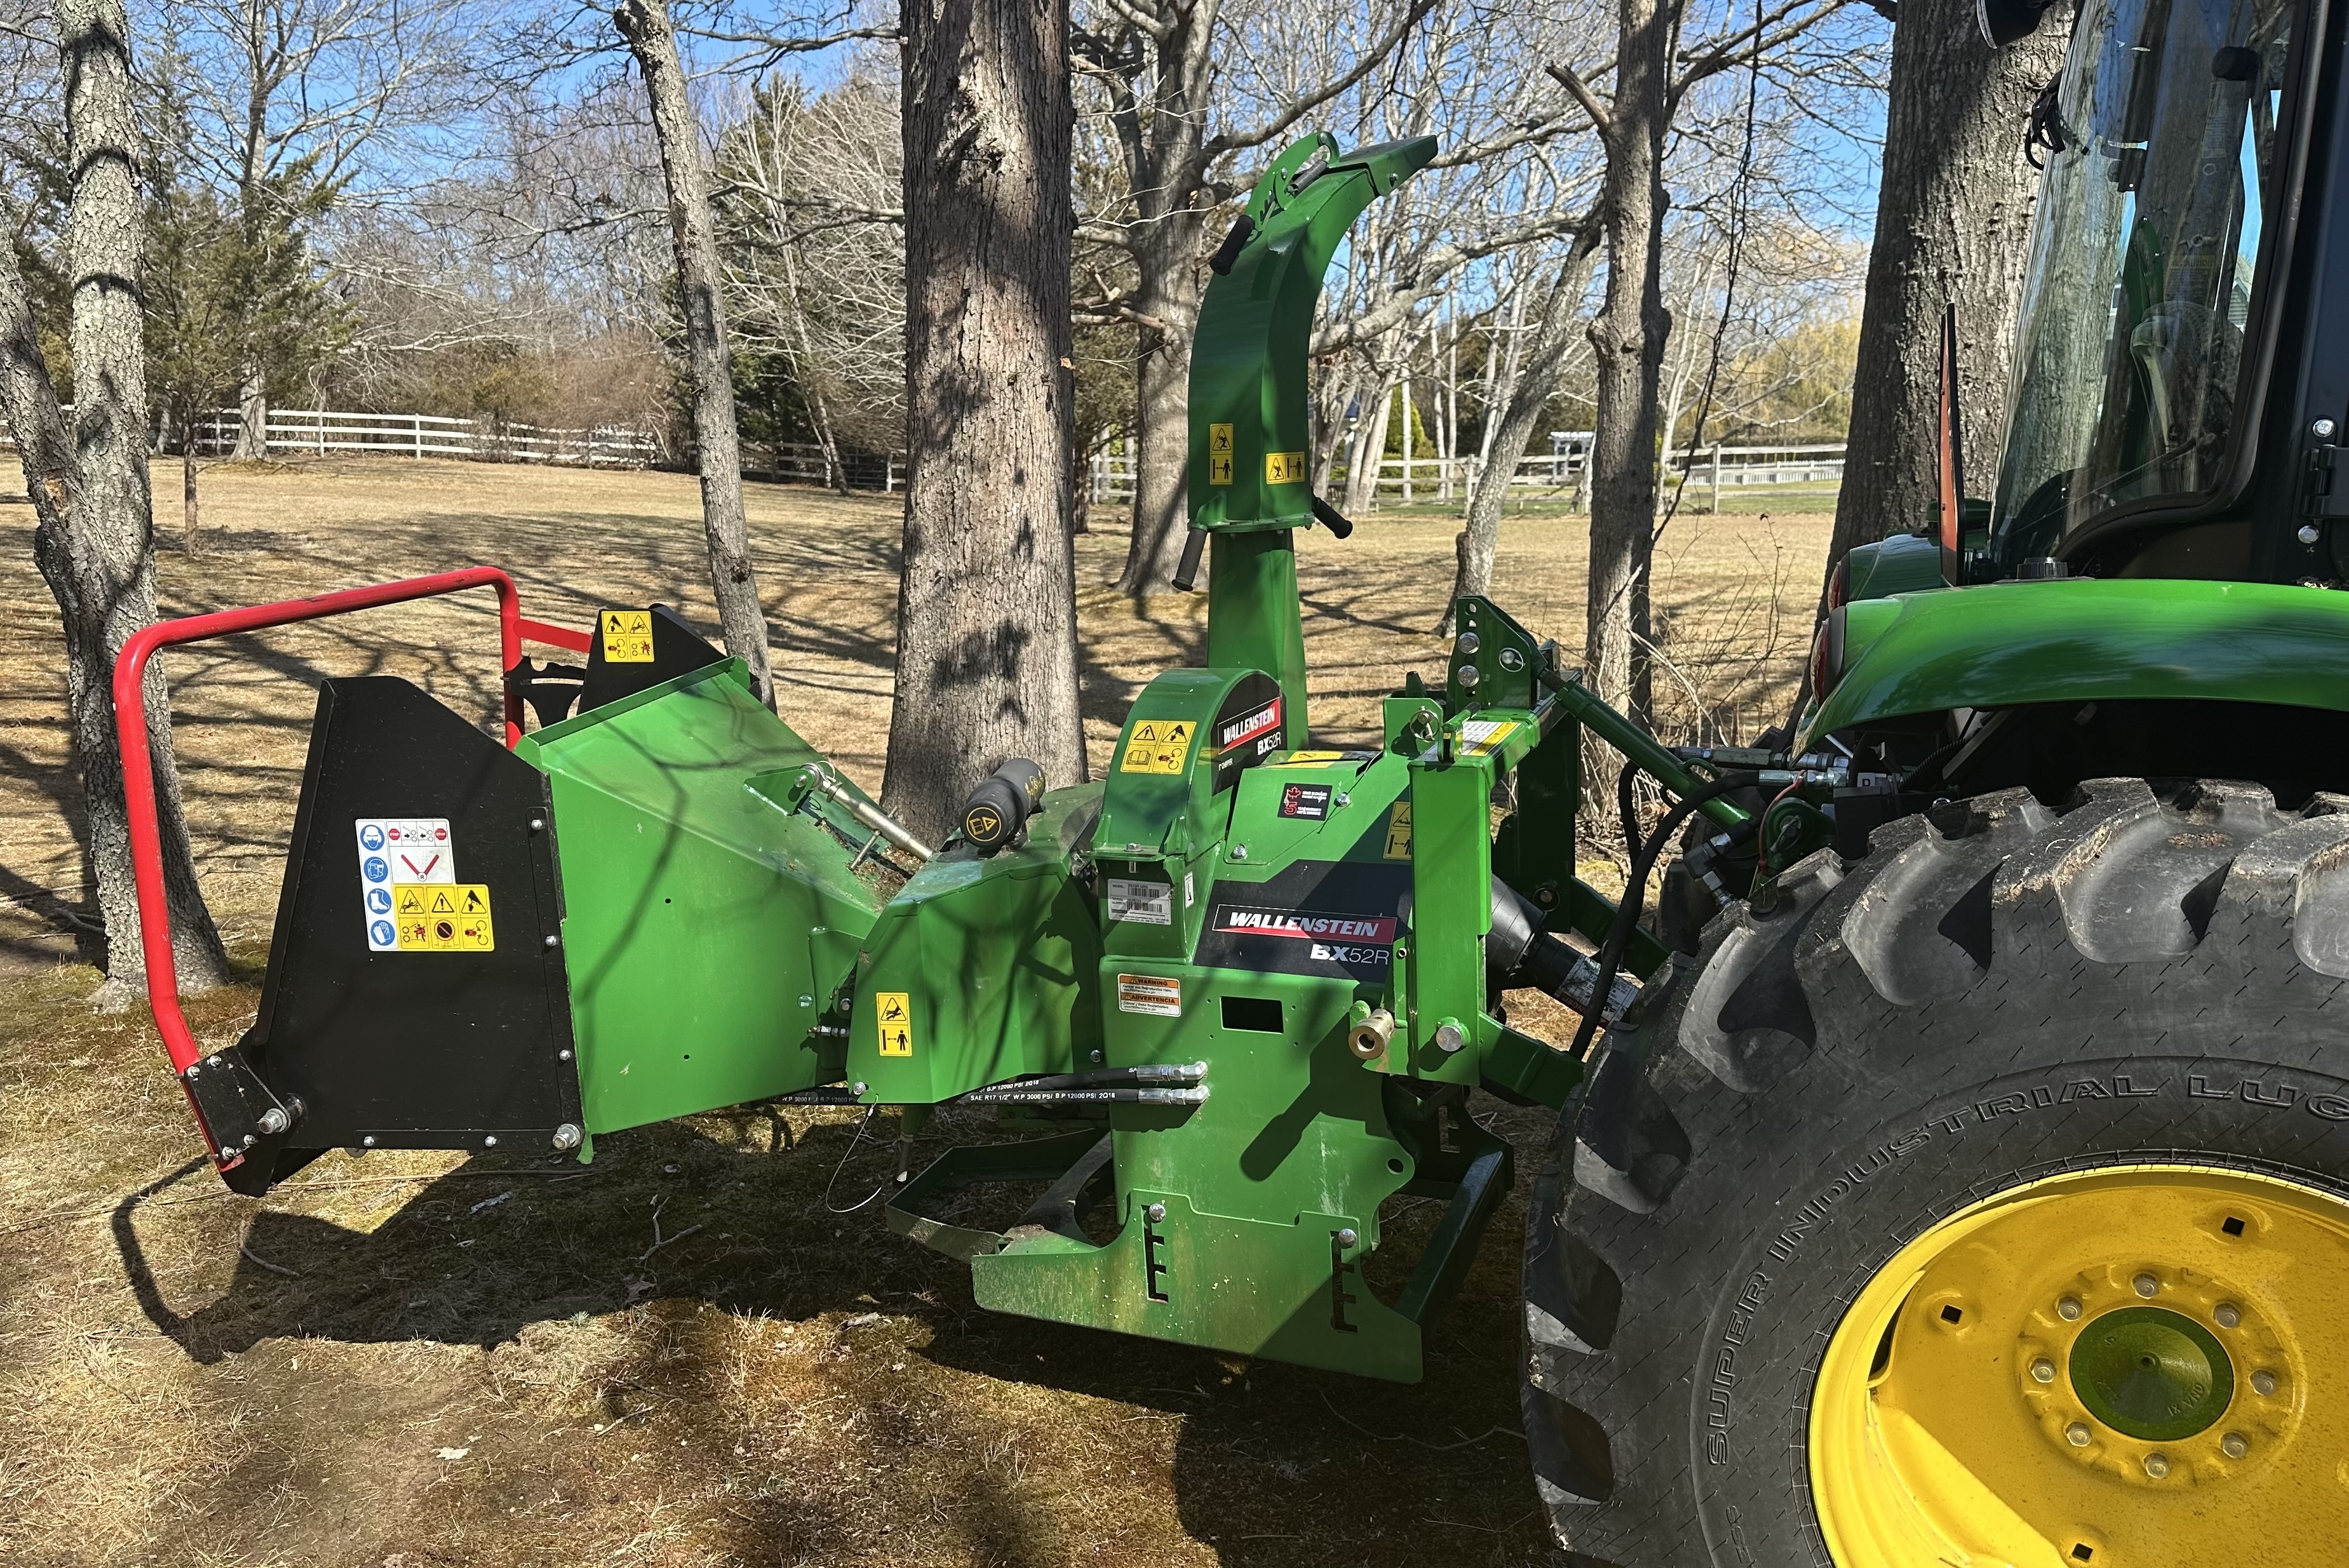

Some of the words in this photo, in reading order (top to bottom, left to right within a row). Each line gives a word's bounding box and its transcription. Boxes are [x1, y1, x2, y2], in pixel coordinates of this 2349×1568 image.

[1223, 706, 1275, 745] WALLENSTEIN
[1257, 732, 1281, 756] BX52R
[1229, 911, 1380, 937] WALLENSTEIN
[1310, 944, 1390, 965] BX52R
[1131, 995, 1176, 1003] ADVERTENCIA
[1767, 1075, 2160, 1261] INDUSTRIAL
[1707, 1271, 1774, 1464] SUPER
